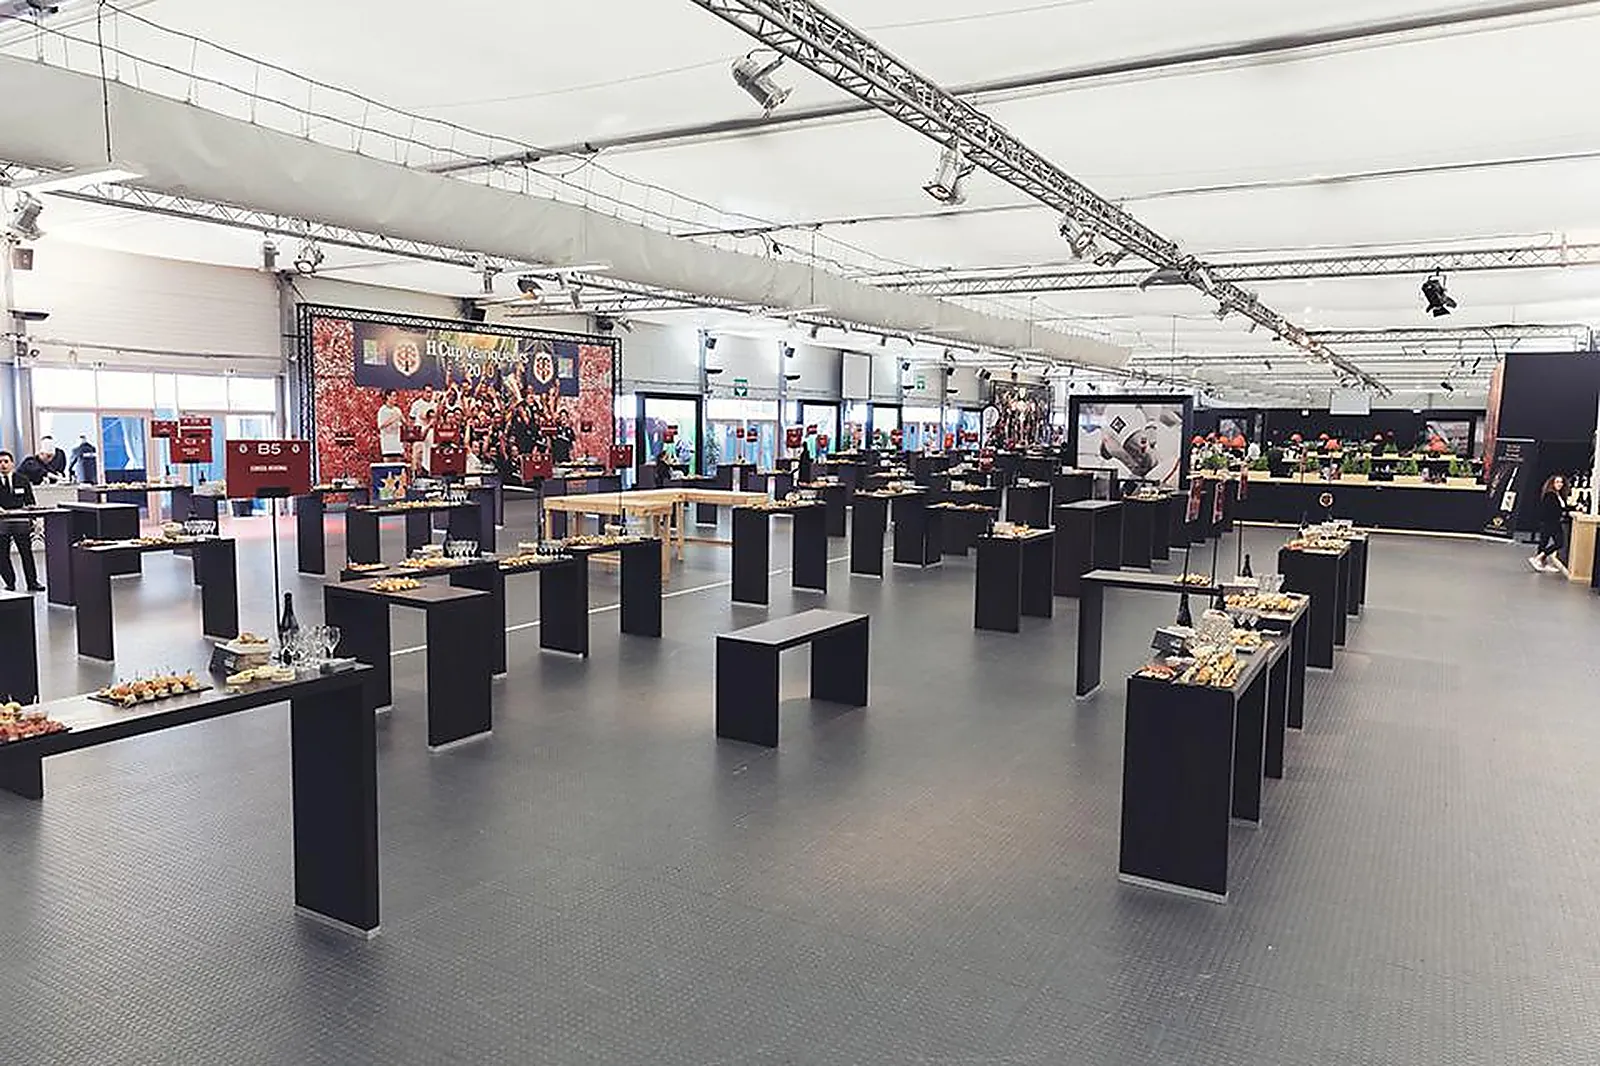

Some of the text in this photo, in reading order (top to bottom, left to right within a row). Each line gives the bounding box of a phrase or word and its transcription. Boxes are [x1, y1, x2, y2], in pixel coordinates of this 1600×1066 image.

[426, 340, 437, 356] H
[438, 341, 463, 362] Cup
[257, 442, 282, 455] B5
